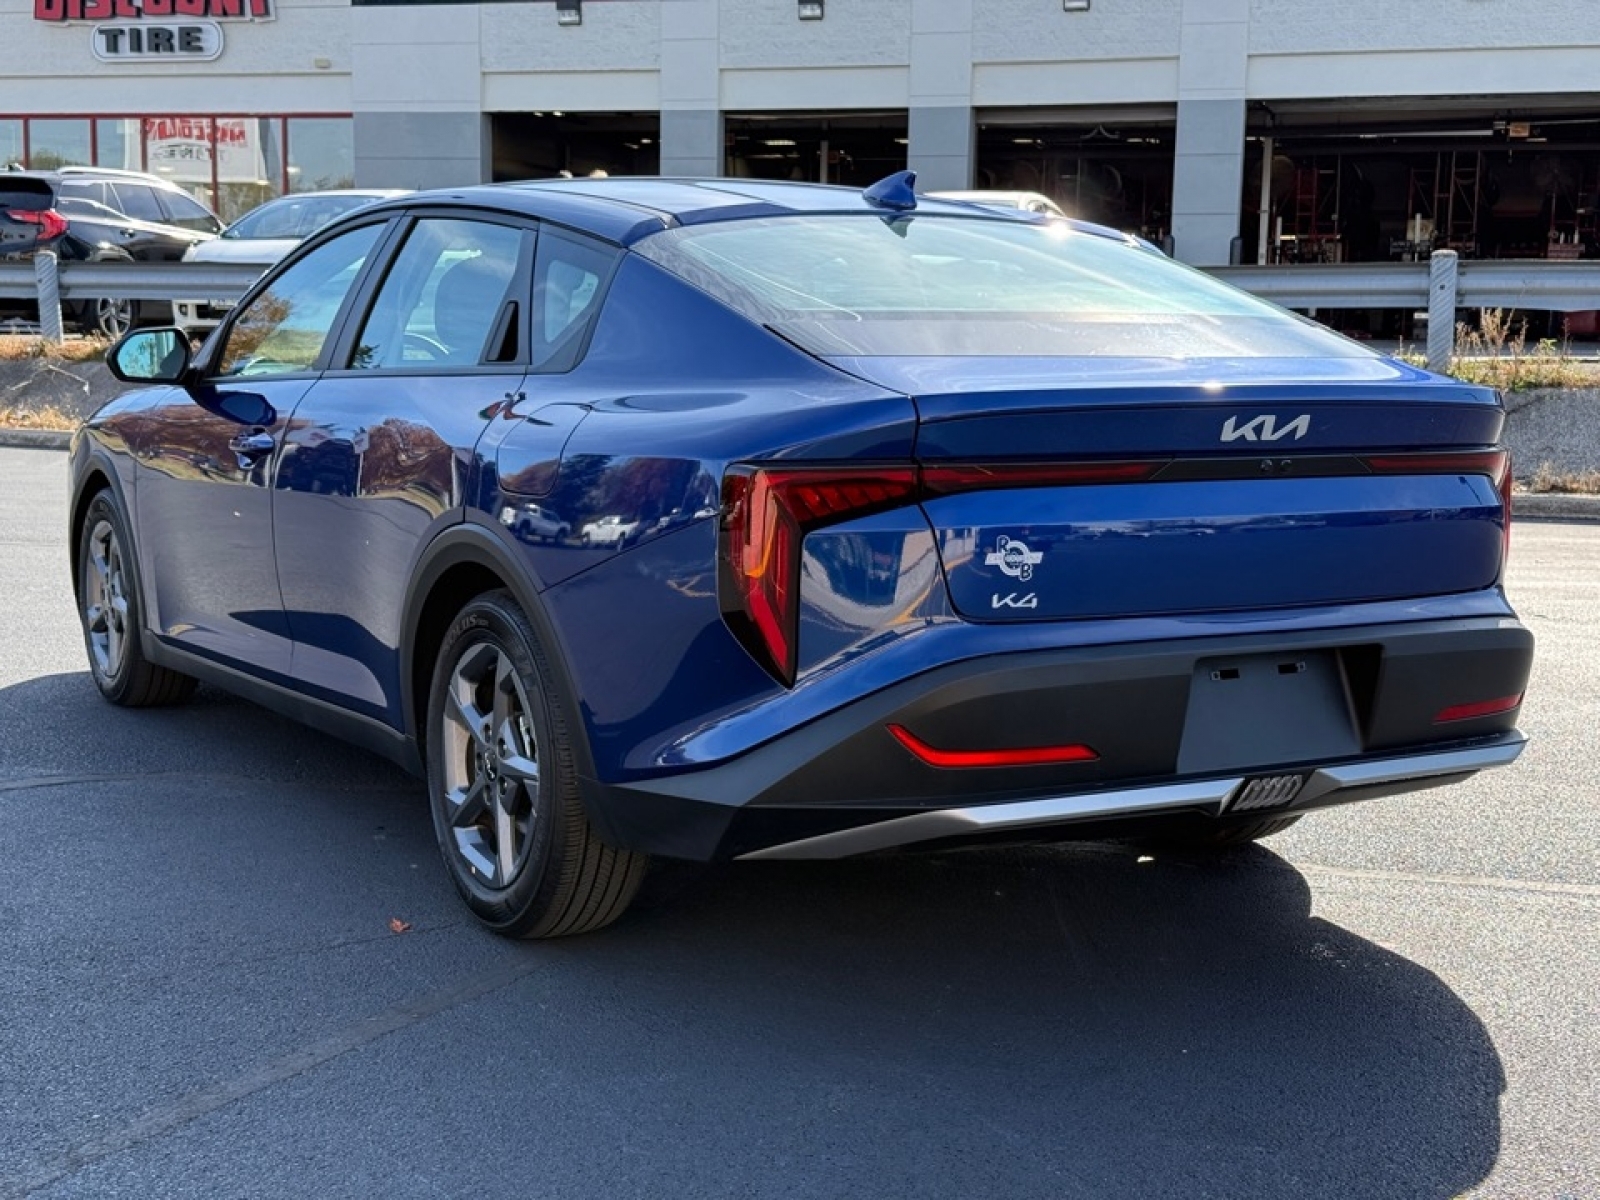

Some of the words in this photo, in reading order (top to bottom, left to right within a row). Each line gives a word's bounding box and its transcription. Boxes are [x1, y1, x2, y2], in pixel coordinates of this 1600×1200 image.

[98, 27, 203, 53] TIRE
[1220, 415, 1311, 441] KIA
[992, 593, 1037, 609] K4
